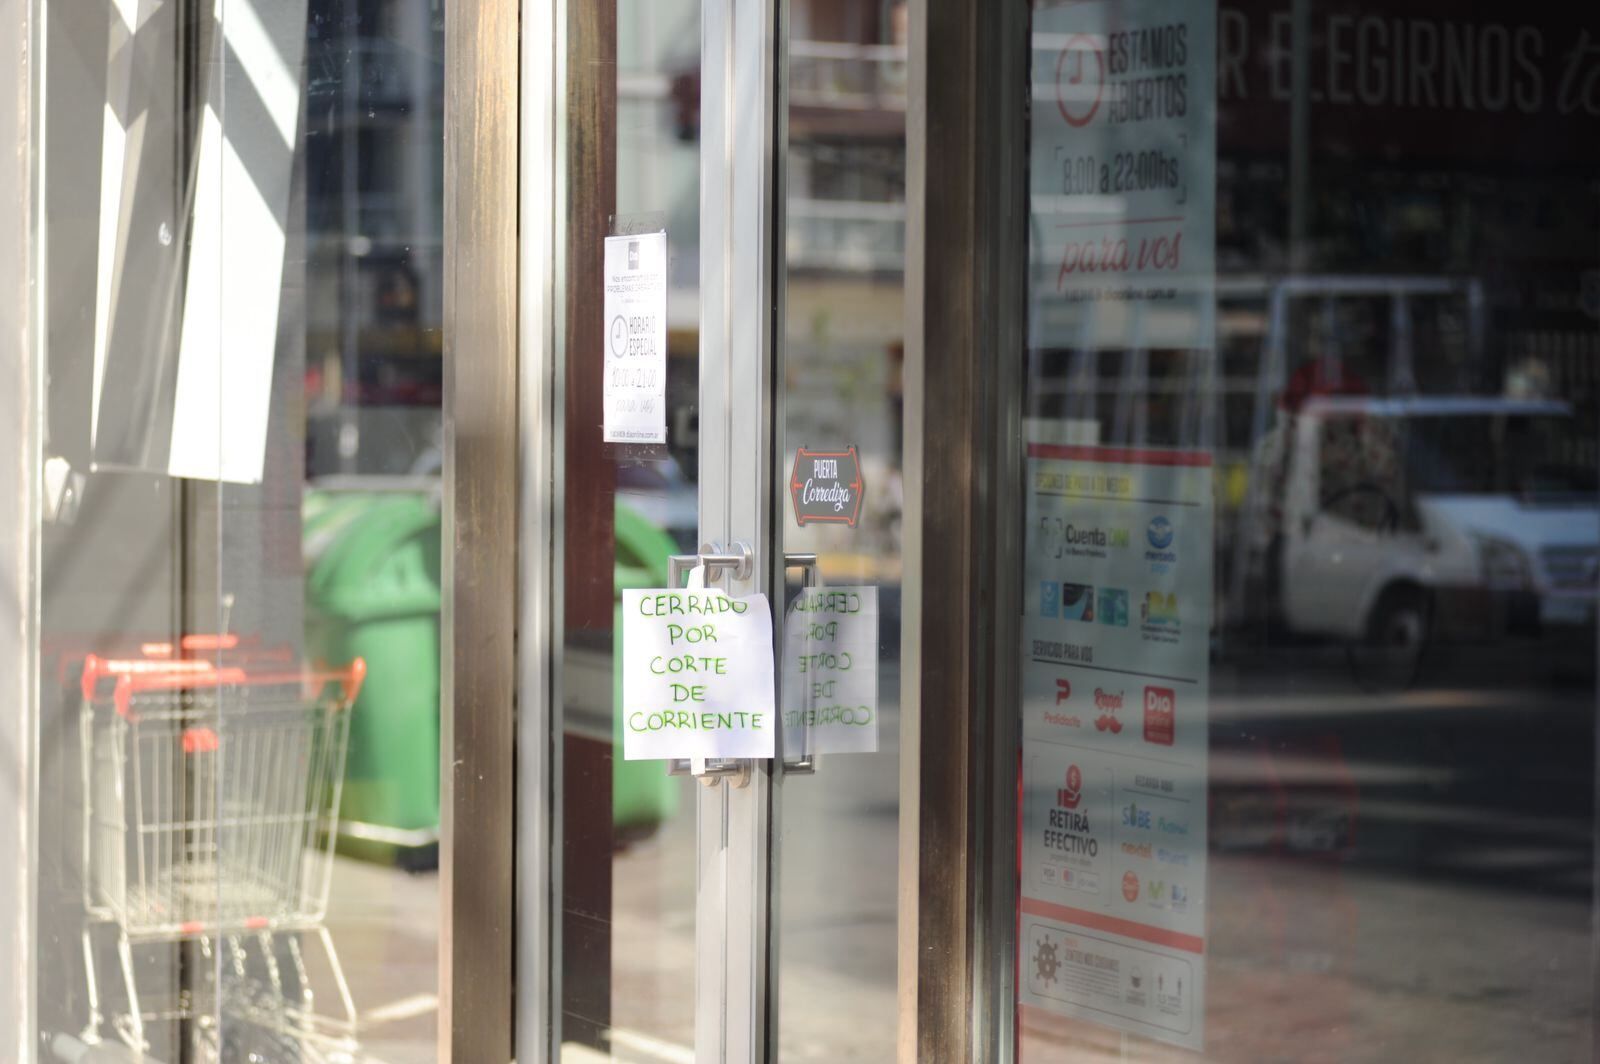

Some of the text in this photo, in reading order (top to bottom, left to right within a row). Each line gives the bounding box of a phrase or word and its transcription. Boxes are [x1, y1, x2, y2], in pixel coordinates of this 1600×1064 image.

[1109, 23, 1188, 75] ESTAMOS
[1270, 11, 1545, 115] EEGIRNOS
[1108, 74, 1188, 124] ABIERTOS
[1063, 156, 1095, 196] 8:00
[1099, 163, 1110, 194] a
[1056, 229, 1182, 292] para vos
[629, 316, 656, 335] HORARIO
[629, 338, 657, 357] ESPECIAL
[814, 459, 838, 479] PUERTA
[803, 478, 851, 512] Corrediza
[1065, 524, 1107, 547] Cuenta
[640, 594, 748, 617] CERRADO
[667, 624, 718, 645] POR
[650, 652, 728, 674] CORTE
[670, 684, 706, 702] DE
[629, 711, 763, 732] CORRIENTE
[1049, 809, 1089, 833] RETIRÁ
[1044, 830, 1098, 858] EFECTIVO
